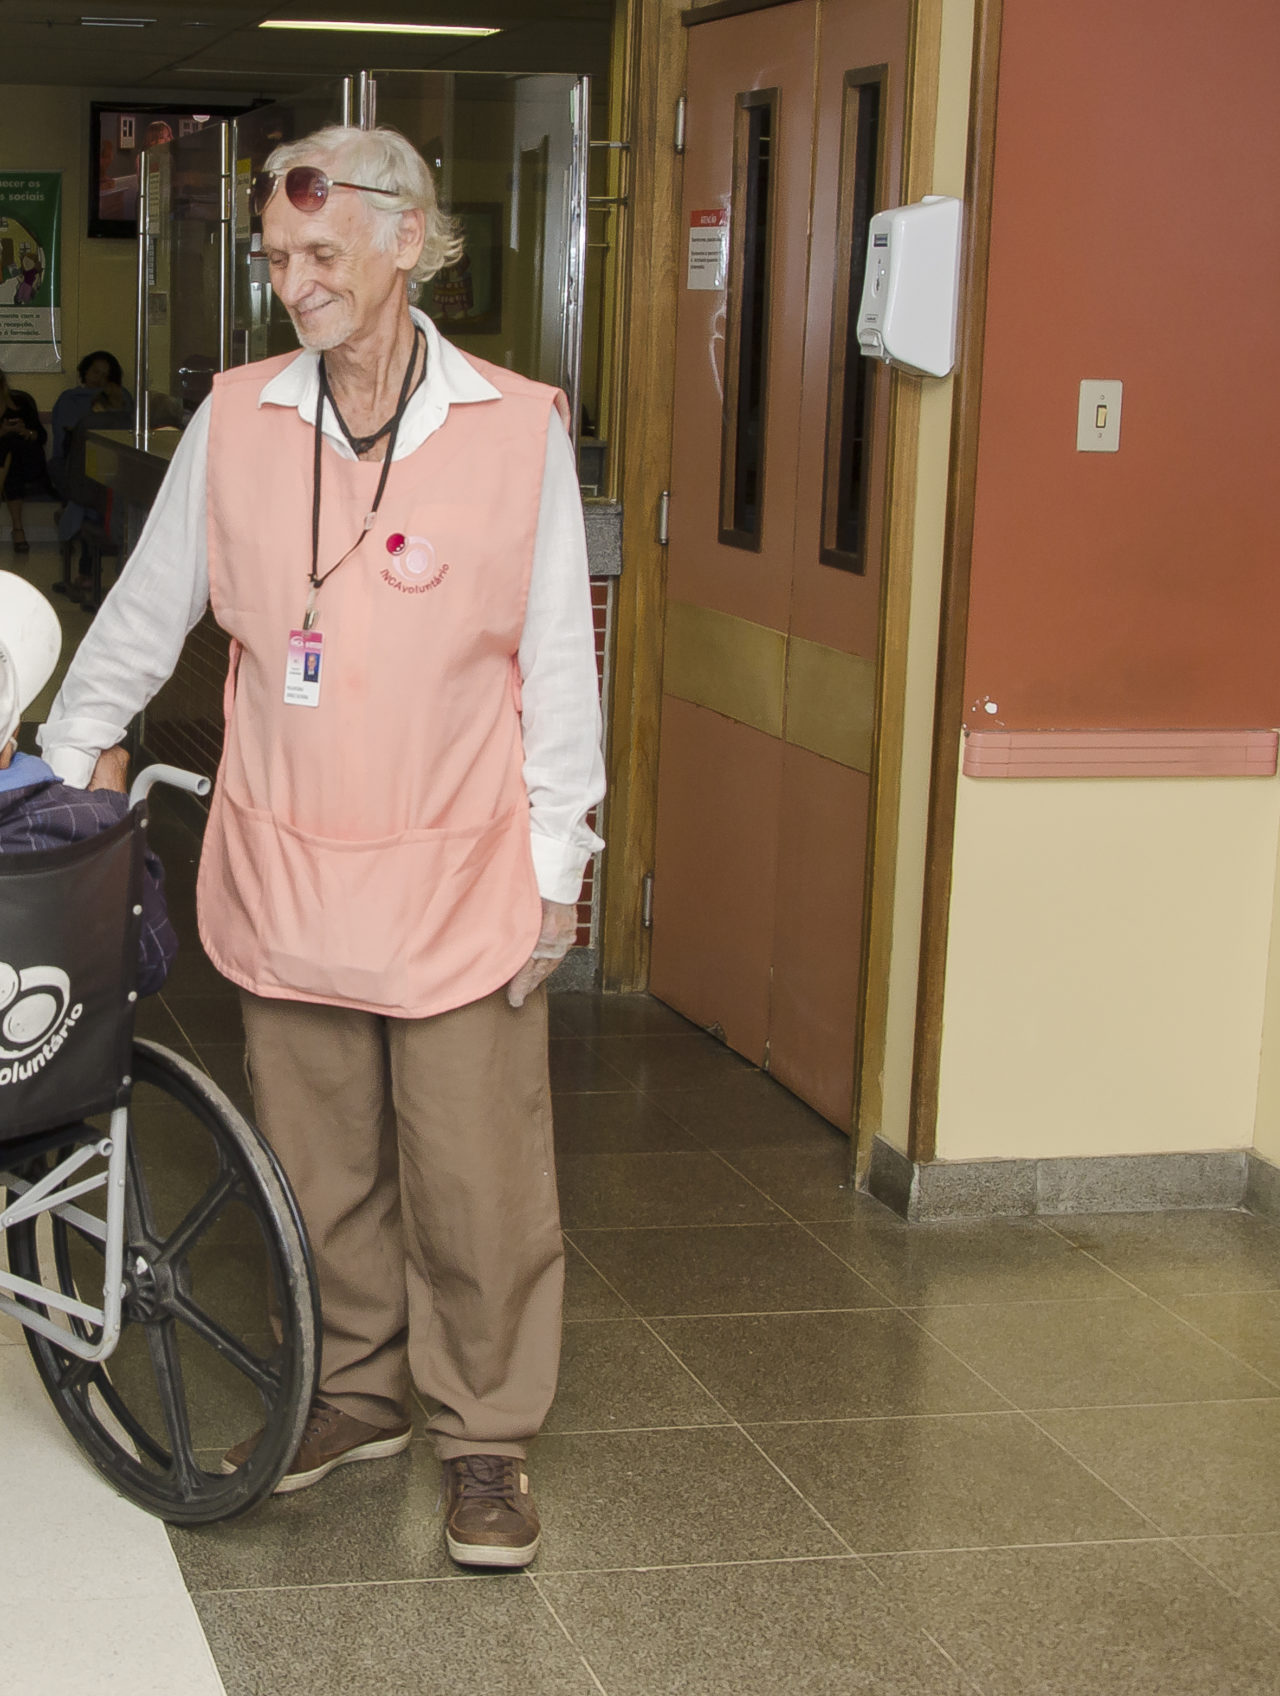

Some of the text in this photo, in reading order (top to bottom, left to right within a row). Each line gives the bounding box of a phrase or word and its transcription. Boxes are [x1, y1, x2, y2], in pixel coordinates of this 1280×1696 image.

[28, 180, 40, 188] os
[9, 190, 45, 201] sociais
[380, 563, 450, 594] INCAvoluntário
